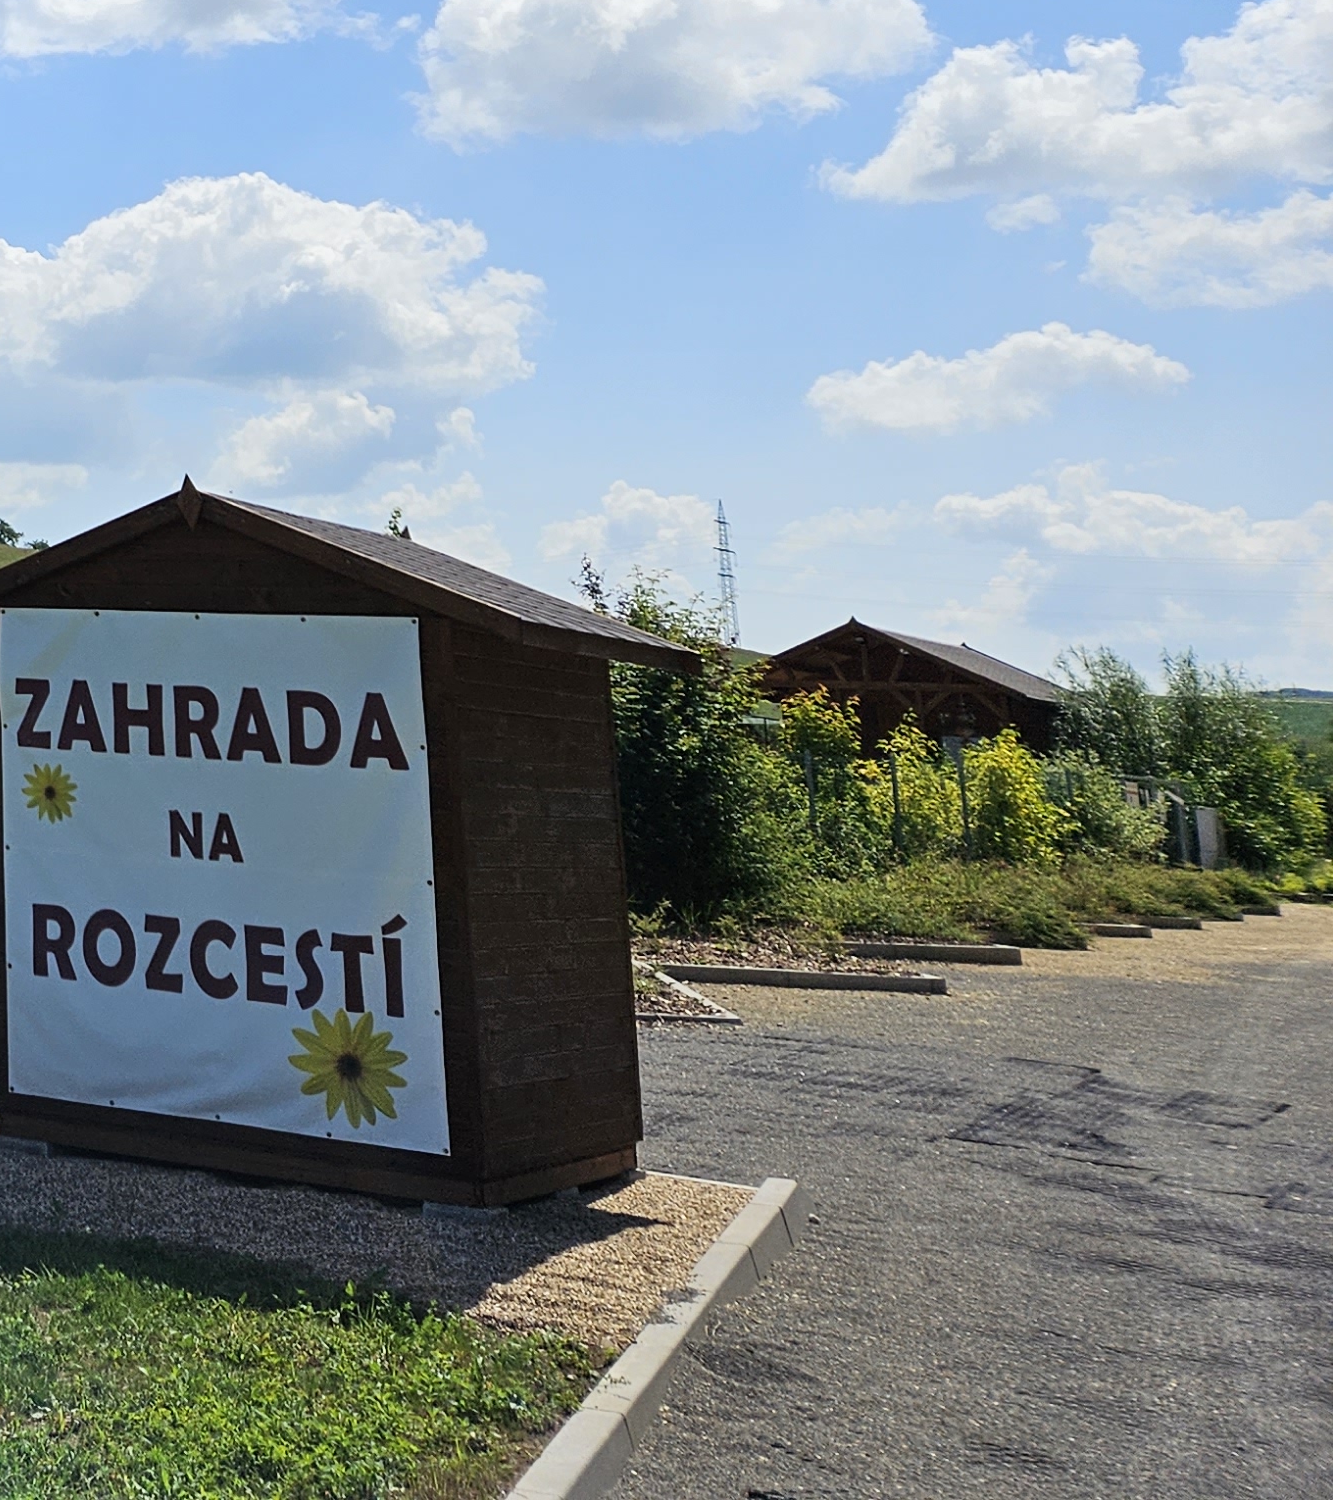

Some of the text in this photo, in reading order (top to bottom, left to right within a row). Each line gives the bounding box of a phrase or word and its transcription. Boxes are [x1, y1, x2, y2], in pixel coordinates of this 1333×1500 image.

[15, 678, 410, 771] ZAHRADA
[168, 809, 244, 863] NA
[32, 903, 408, 1018] ROZCESTÍ
